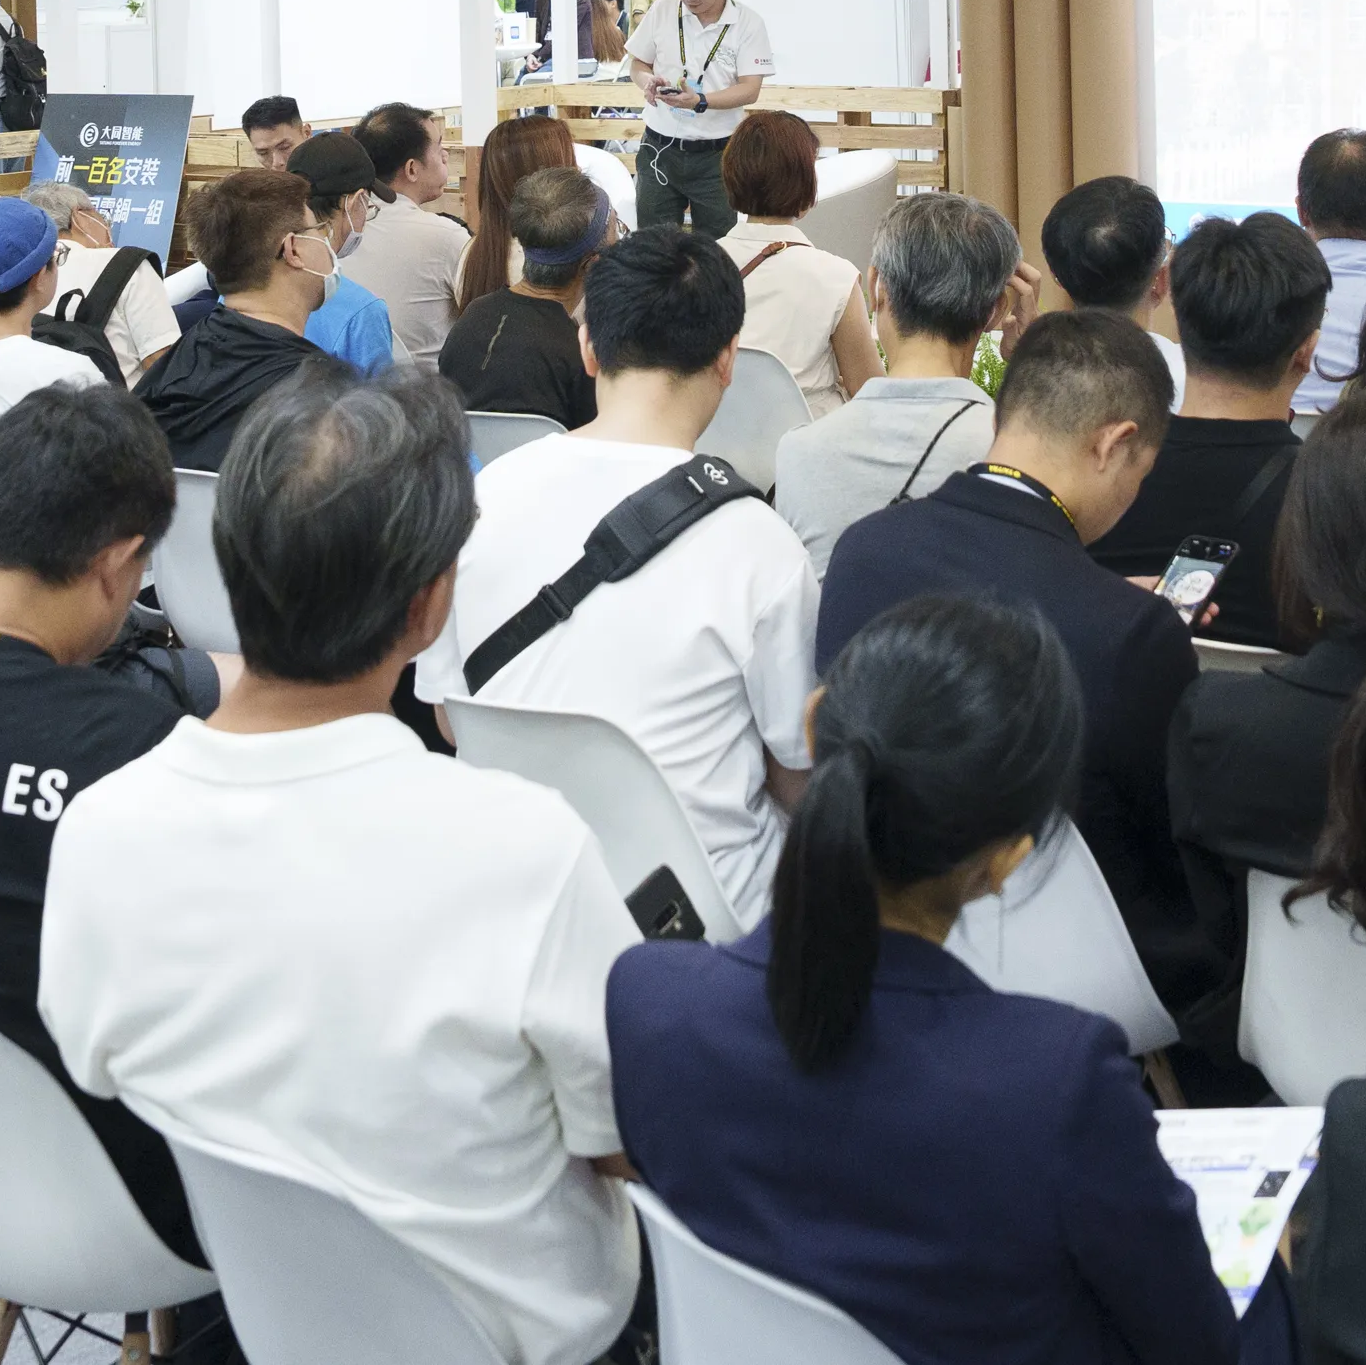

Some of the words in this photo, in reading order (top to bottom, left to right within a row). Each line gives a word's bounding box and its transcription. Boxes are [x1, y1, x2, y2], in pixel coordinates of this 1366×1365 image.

[100, 125, 144, 141] 大同智能
[54, 155, 161, 186] 前一百名安裝
